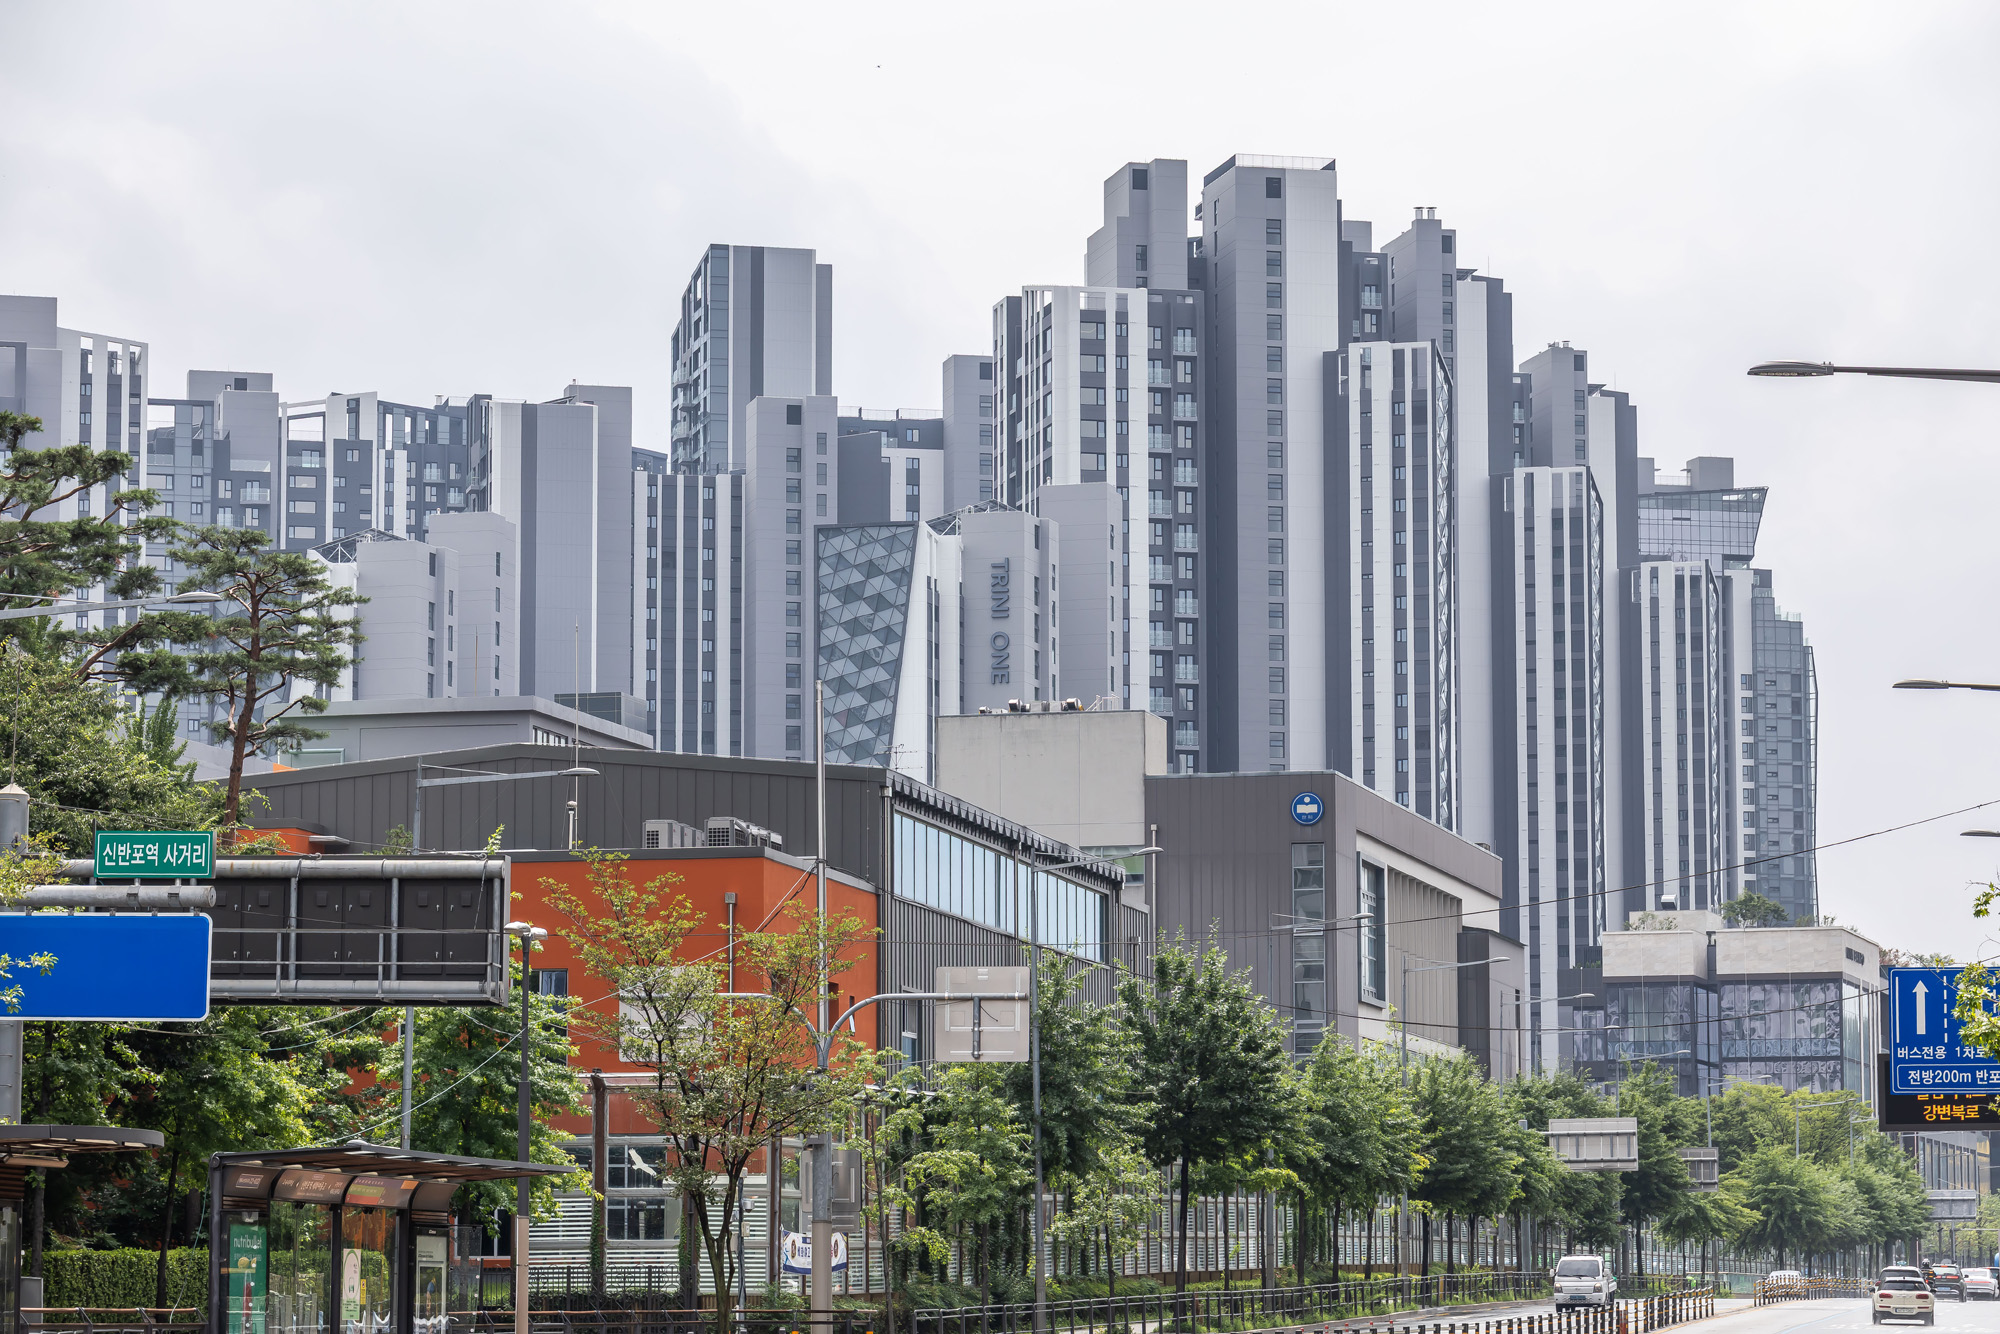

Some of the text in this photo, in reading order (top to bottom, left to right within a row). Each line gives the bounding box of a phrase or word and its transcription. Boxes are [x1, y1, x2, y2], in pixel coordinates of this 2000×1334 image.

[990, 557, 1009, 685] TRINI ONE
[103, 842, 206, 866] 신반포역 사거리
[1897, 1046, 1947, 1059] 버스전용
[1908, 1069, 2000, 1084] 전방200m 반포
[1923, 1104, 1980, 1121] 강변북로
